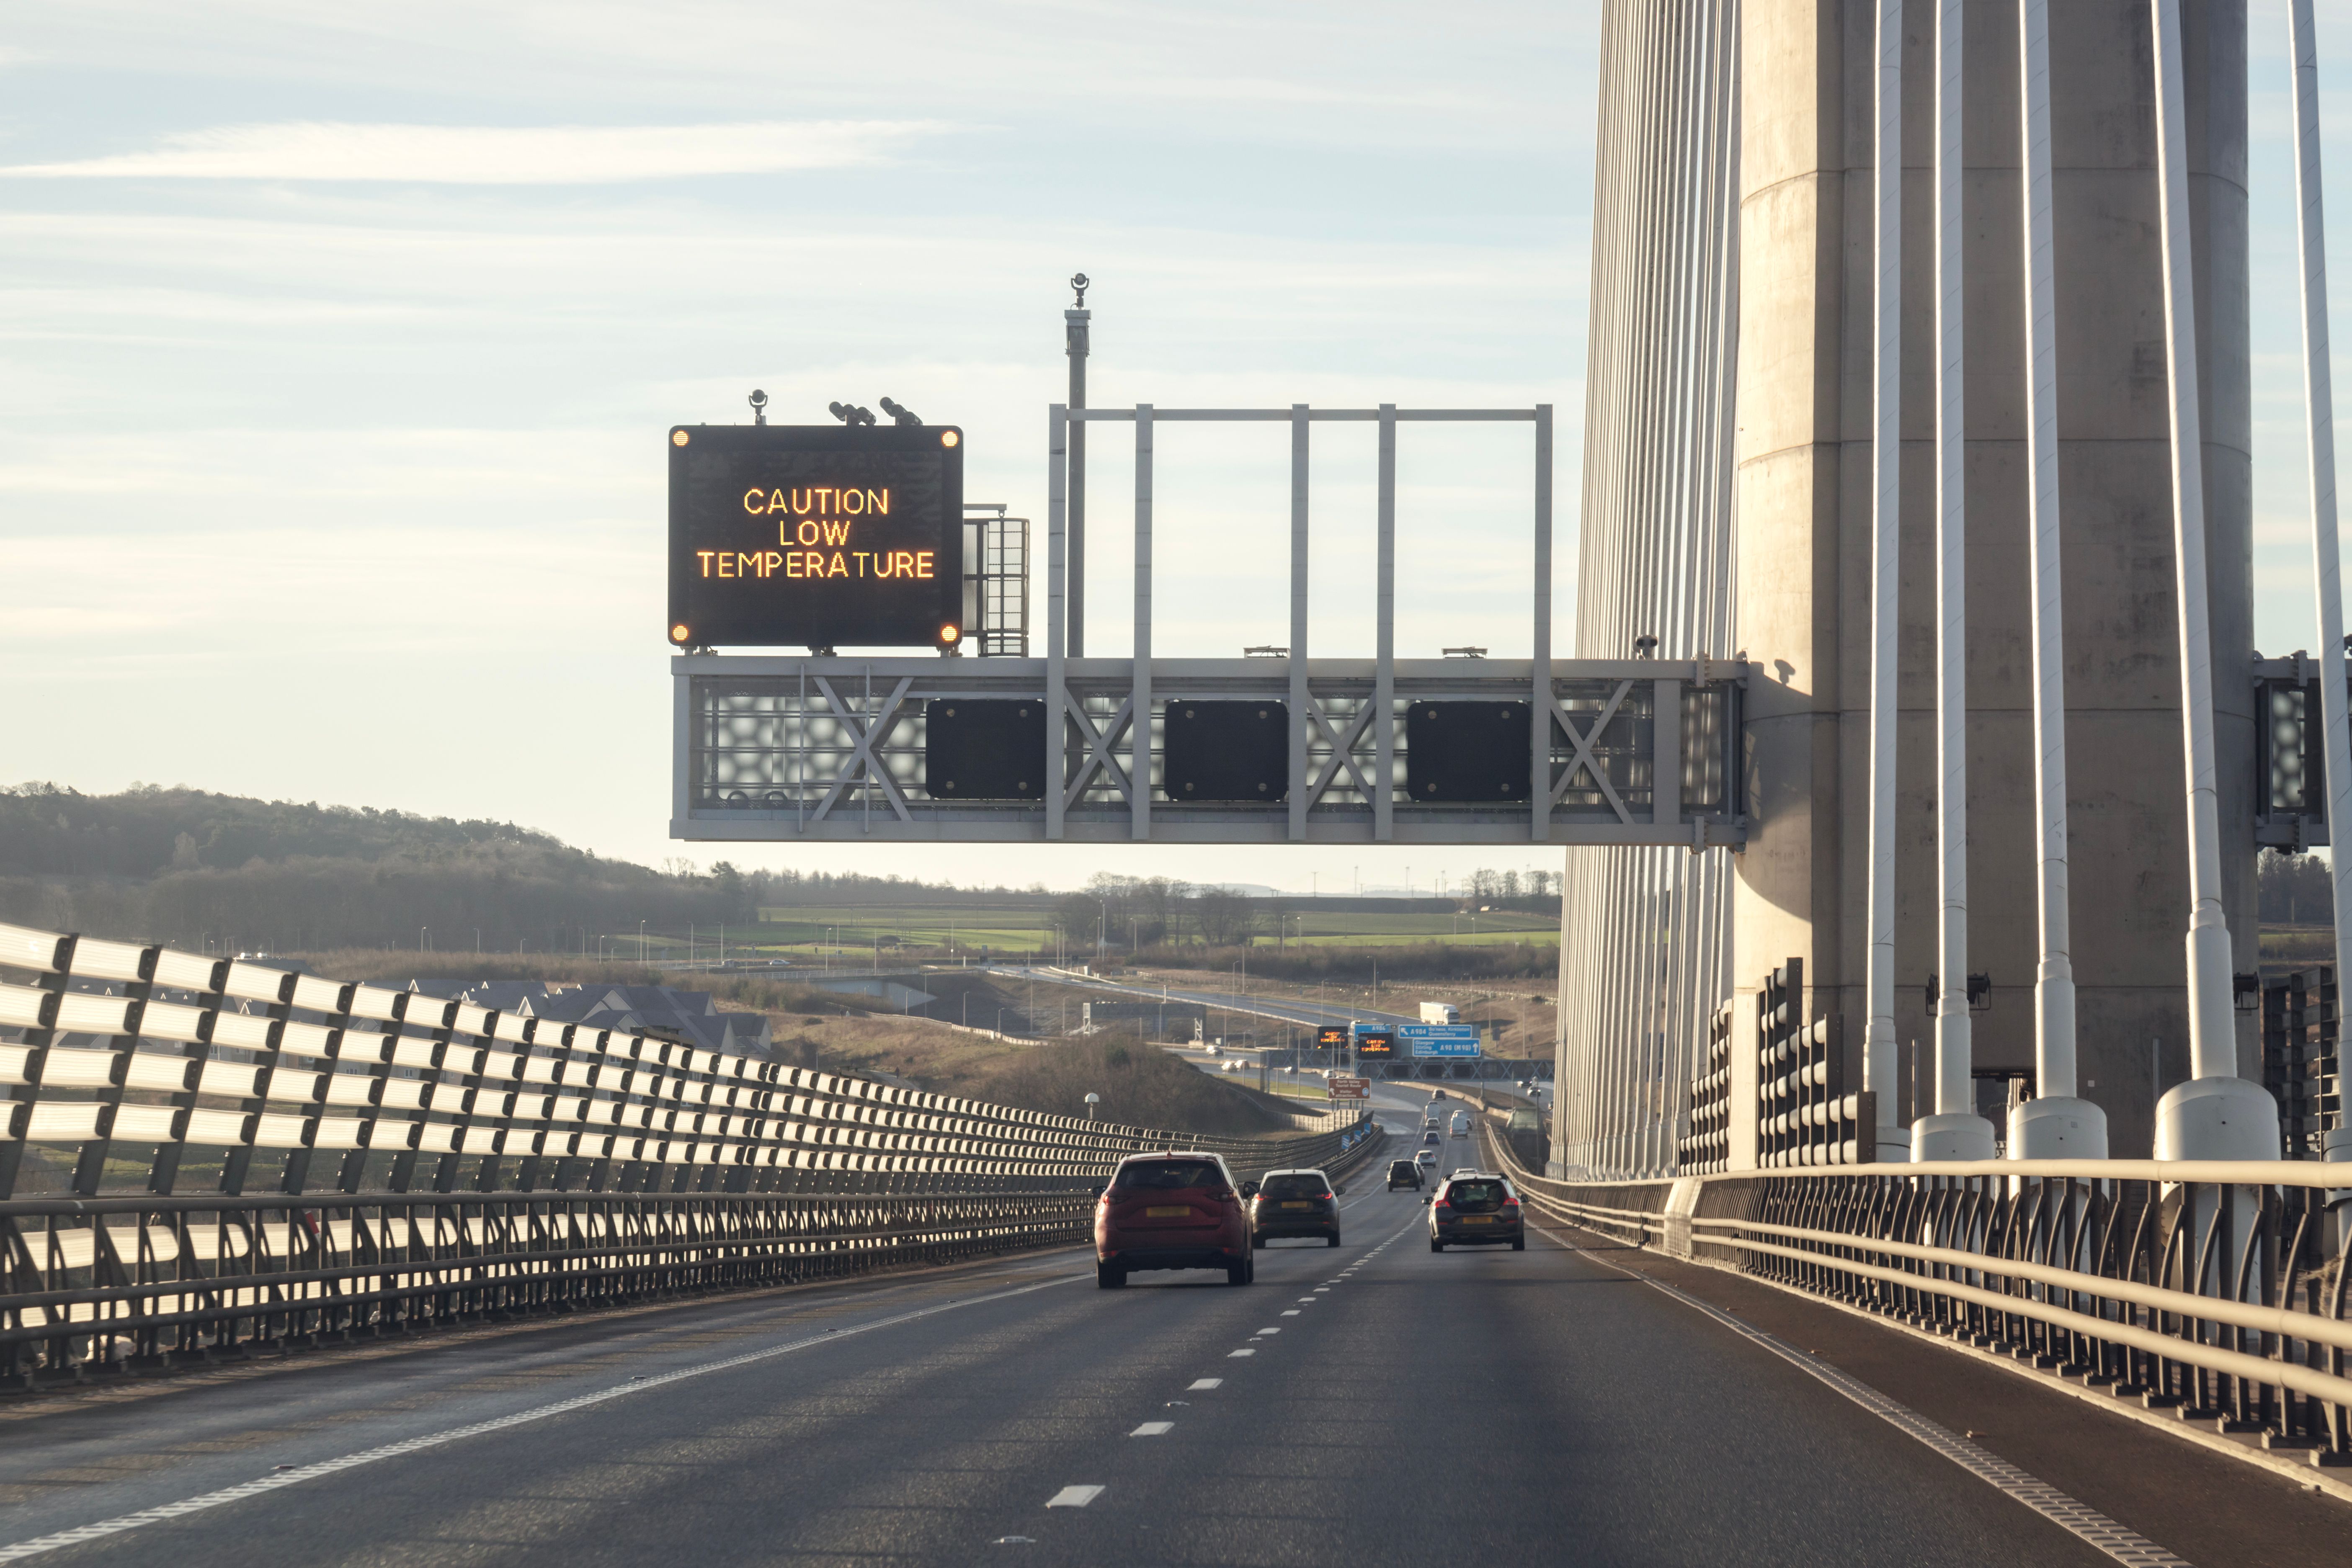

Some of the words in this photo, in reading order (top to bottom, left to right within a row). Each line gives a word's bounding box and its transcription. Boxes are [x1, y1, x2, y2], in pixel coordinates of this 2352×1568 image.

[744, 489, 888, 514] CAUTION
[780, 520, 850, 546] LOW
[697, 552, 934, 578] TEMPERATURE
